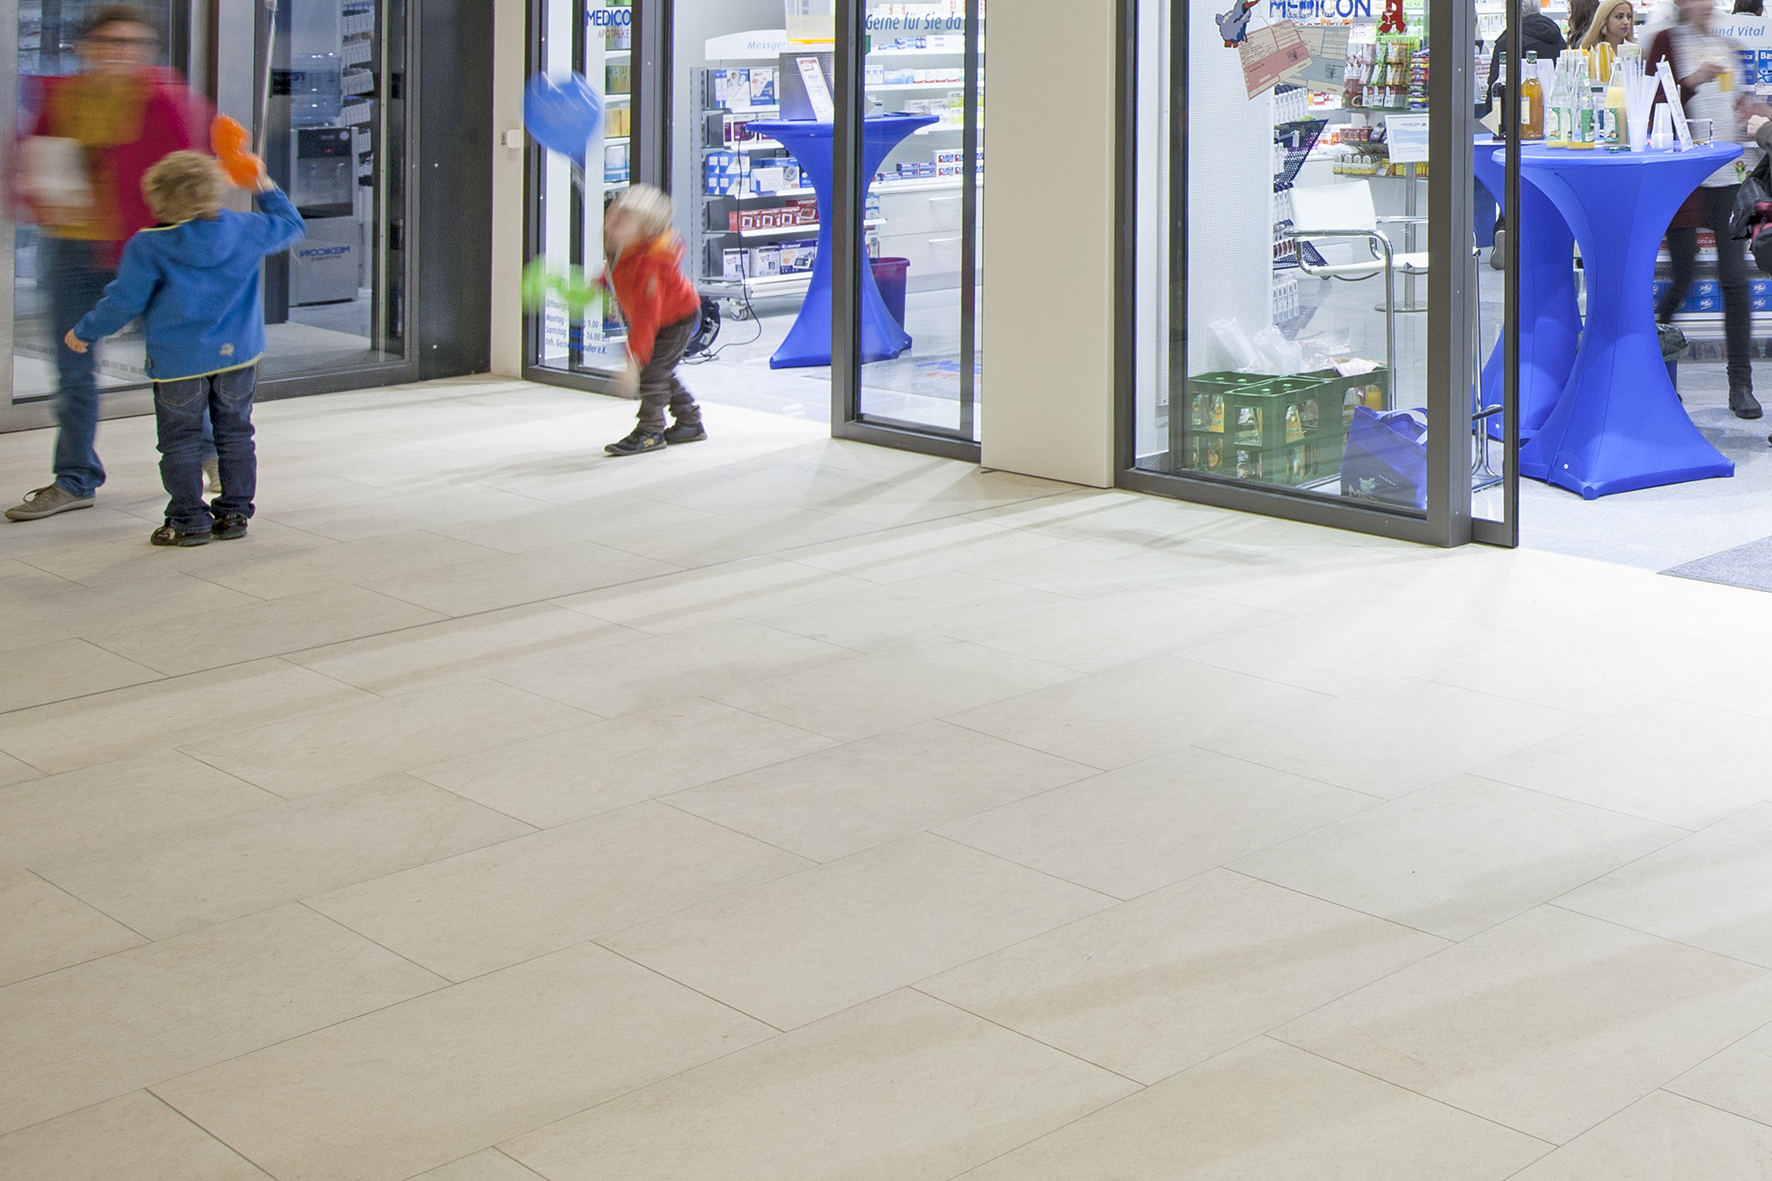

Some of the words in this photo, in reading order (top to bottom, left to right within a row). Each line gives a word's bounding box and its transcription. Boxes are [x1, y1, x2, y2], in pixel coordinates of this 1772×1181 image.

[586, 9, 632, 26] MEDICO
[865, 13, 900, 30] Gerne
[903, 12, 921, 30] für
[924, 13, 942, 30] Sie
[945, 11, 962, 30] da
[1738, 26, 1766, 37] Vital
